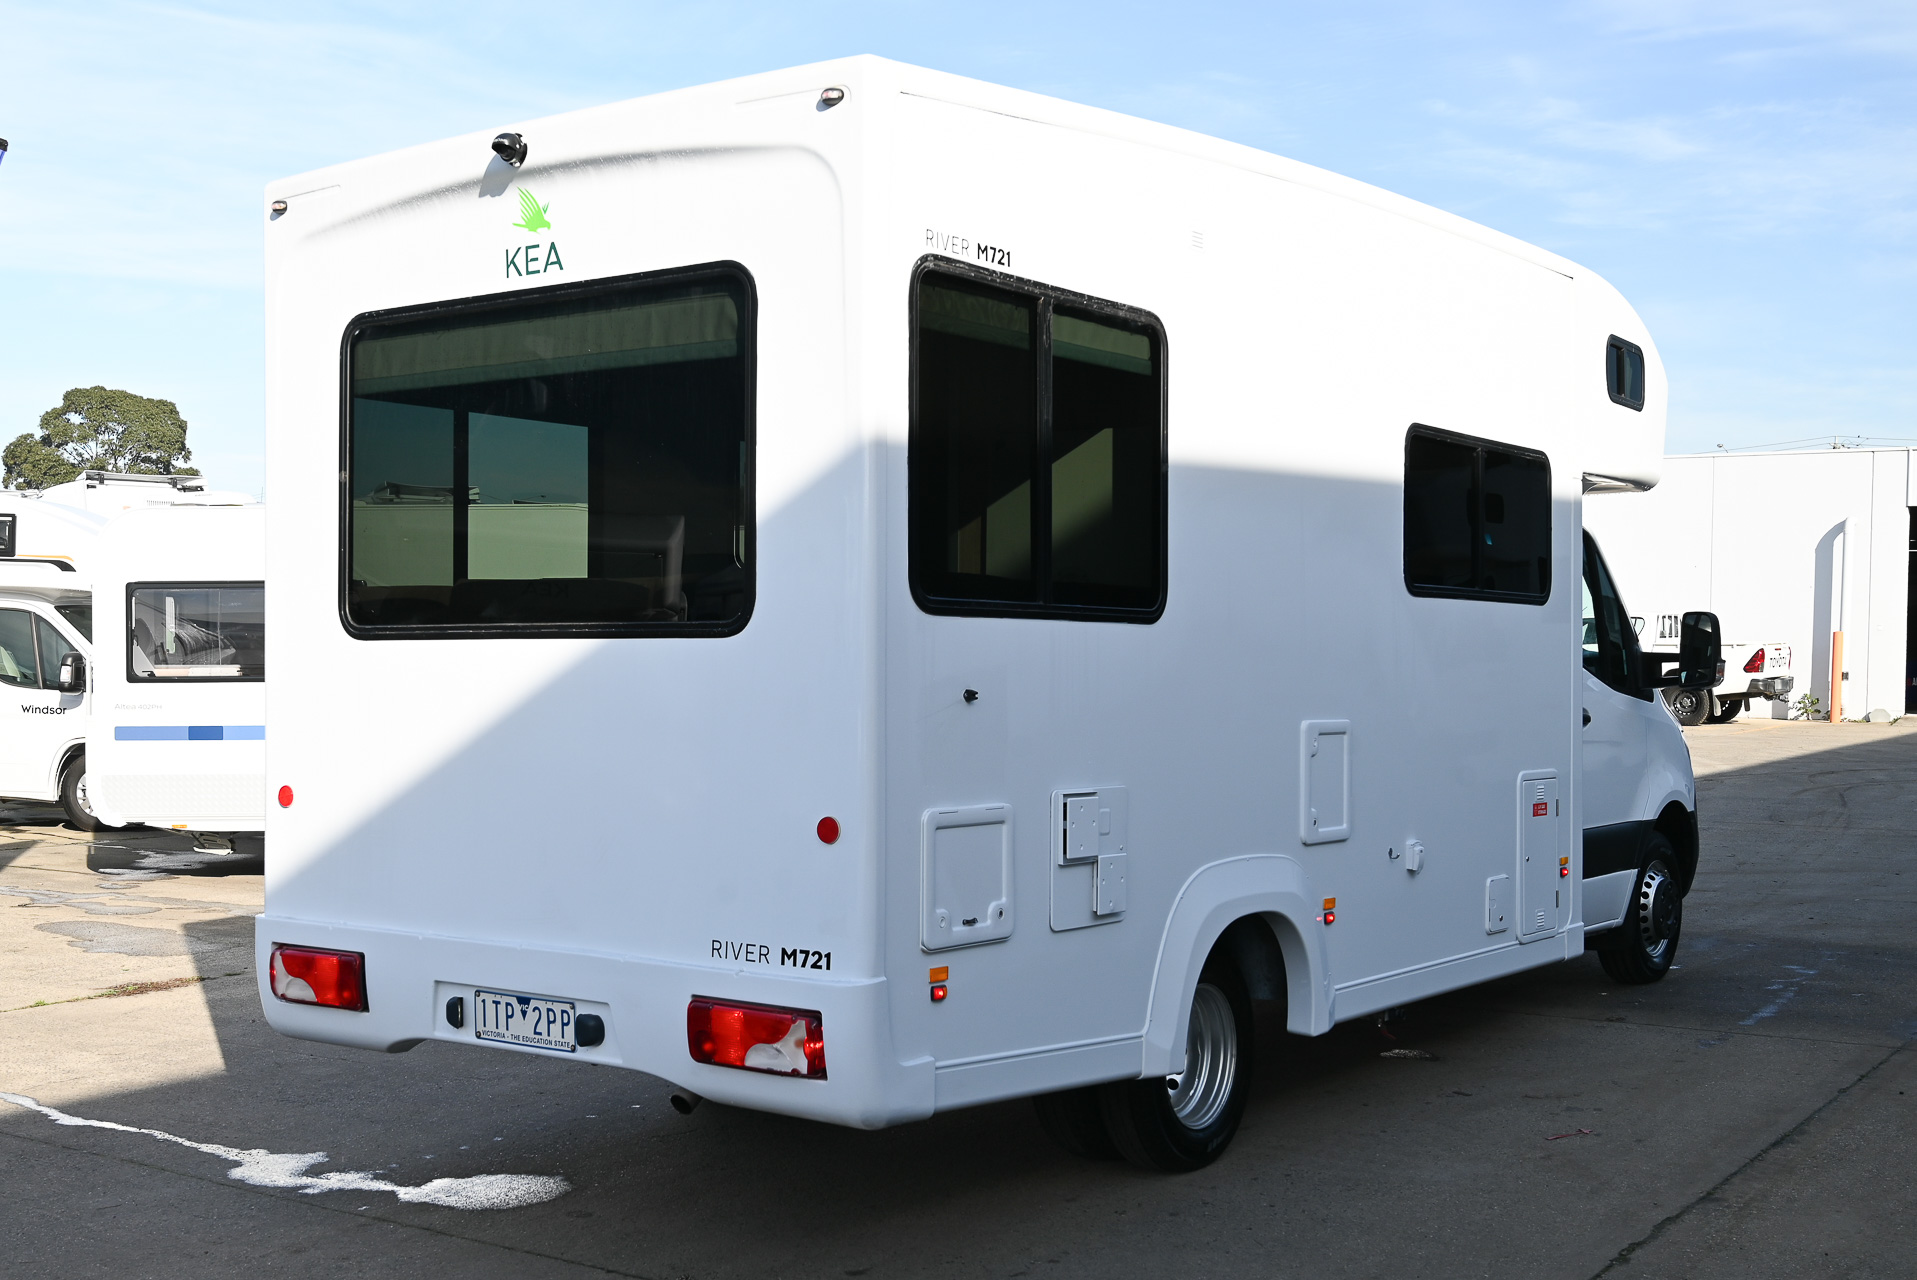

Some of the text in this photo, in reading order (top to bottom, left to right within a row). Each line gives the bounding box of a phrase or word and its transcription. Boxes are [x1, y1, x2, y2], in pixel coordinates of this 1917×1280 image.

[505, 241, 564, 279] KEA
[925, 228, 1011, 267] RIVER M721
[1770, 656, 1787, 668] TOYOTA
[21, 704, 67, 715] Windsor
[711, 939, 831, 971] RIVER M721
[481, 998, 571, 1039] 1TP 2PP
[481, 1029, 505, 1039] VICTORIA
[510, 1033, 521, 1041] THE
[521, 1035, 553, 1046] EDUCATION
[553, 1041, 571, 1049] STATE
